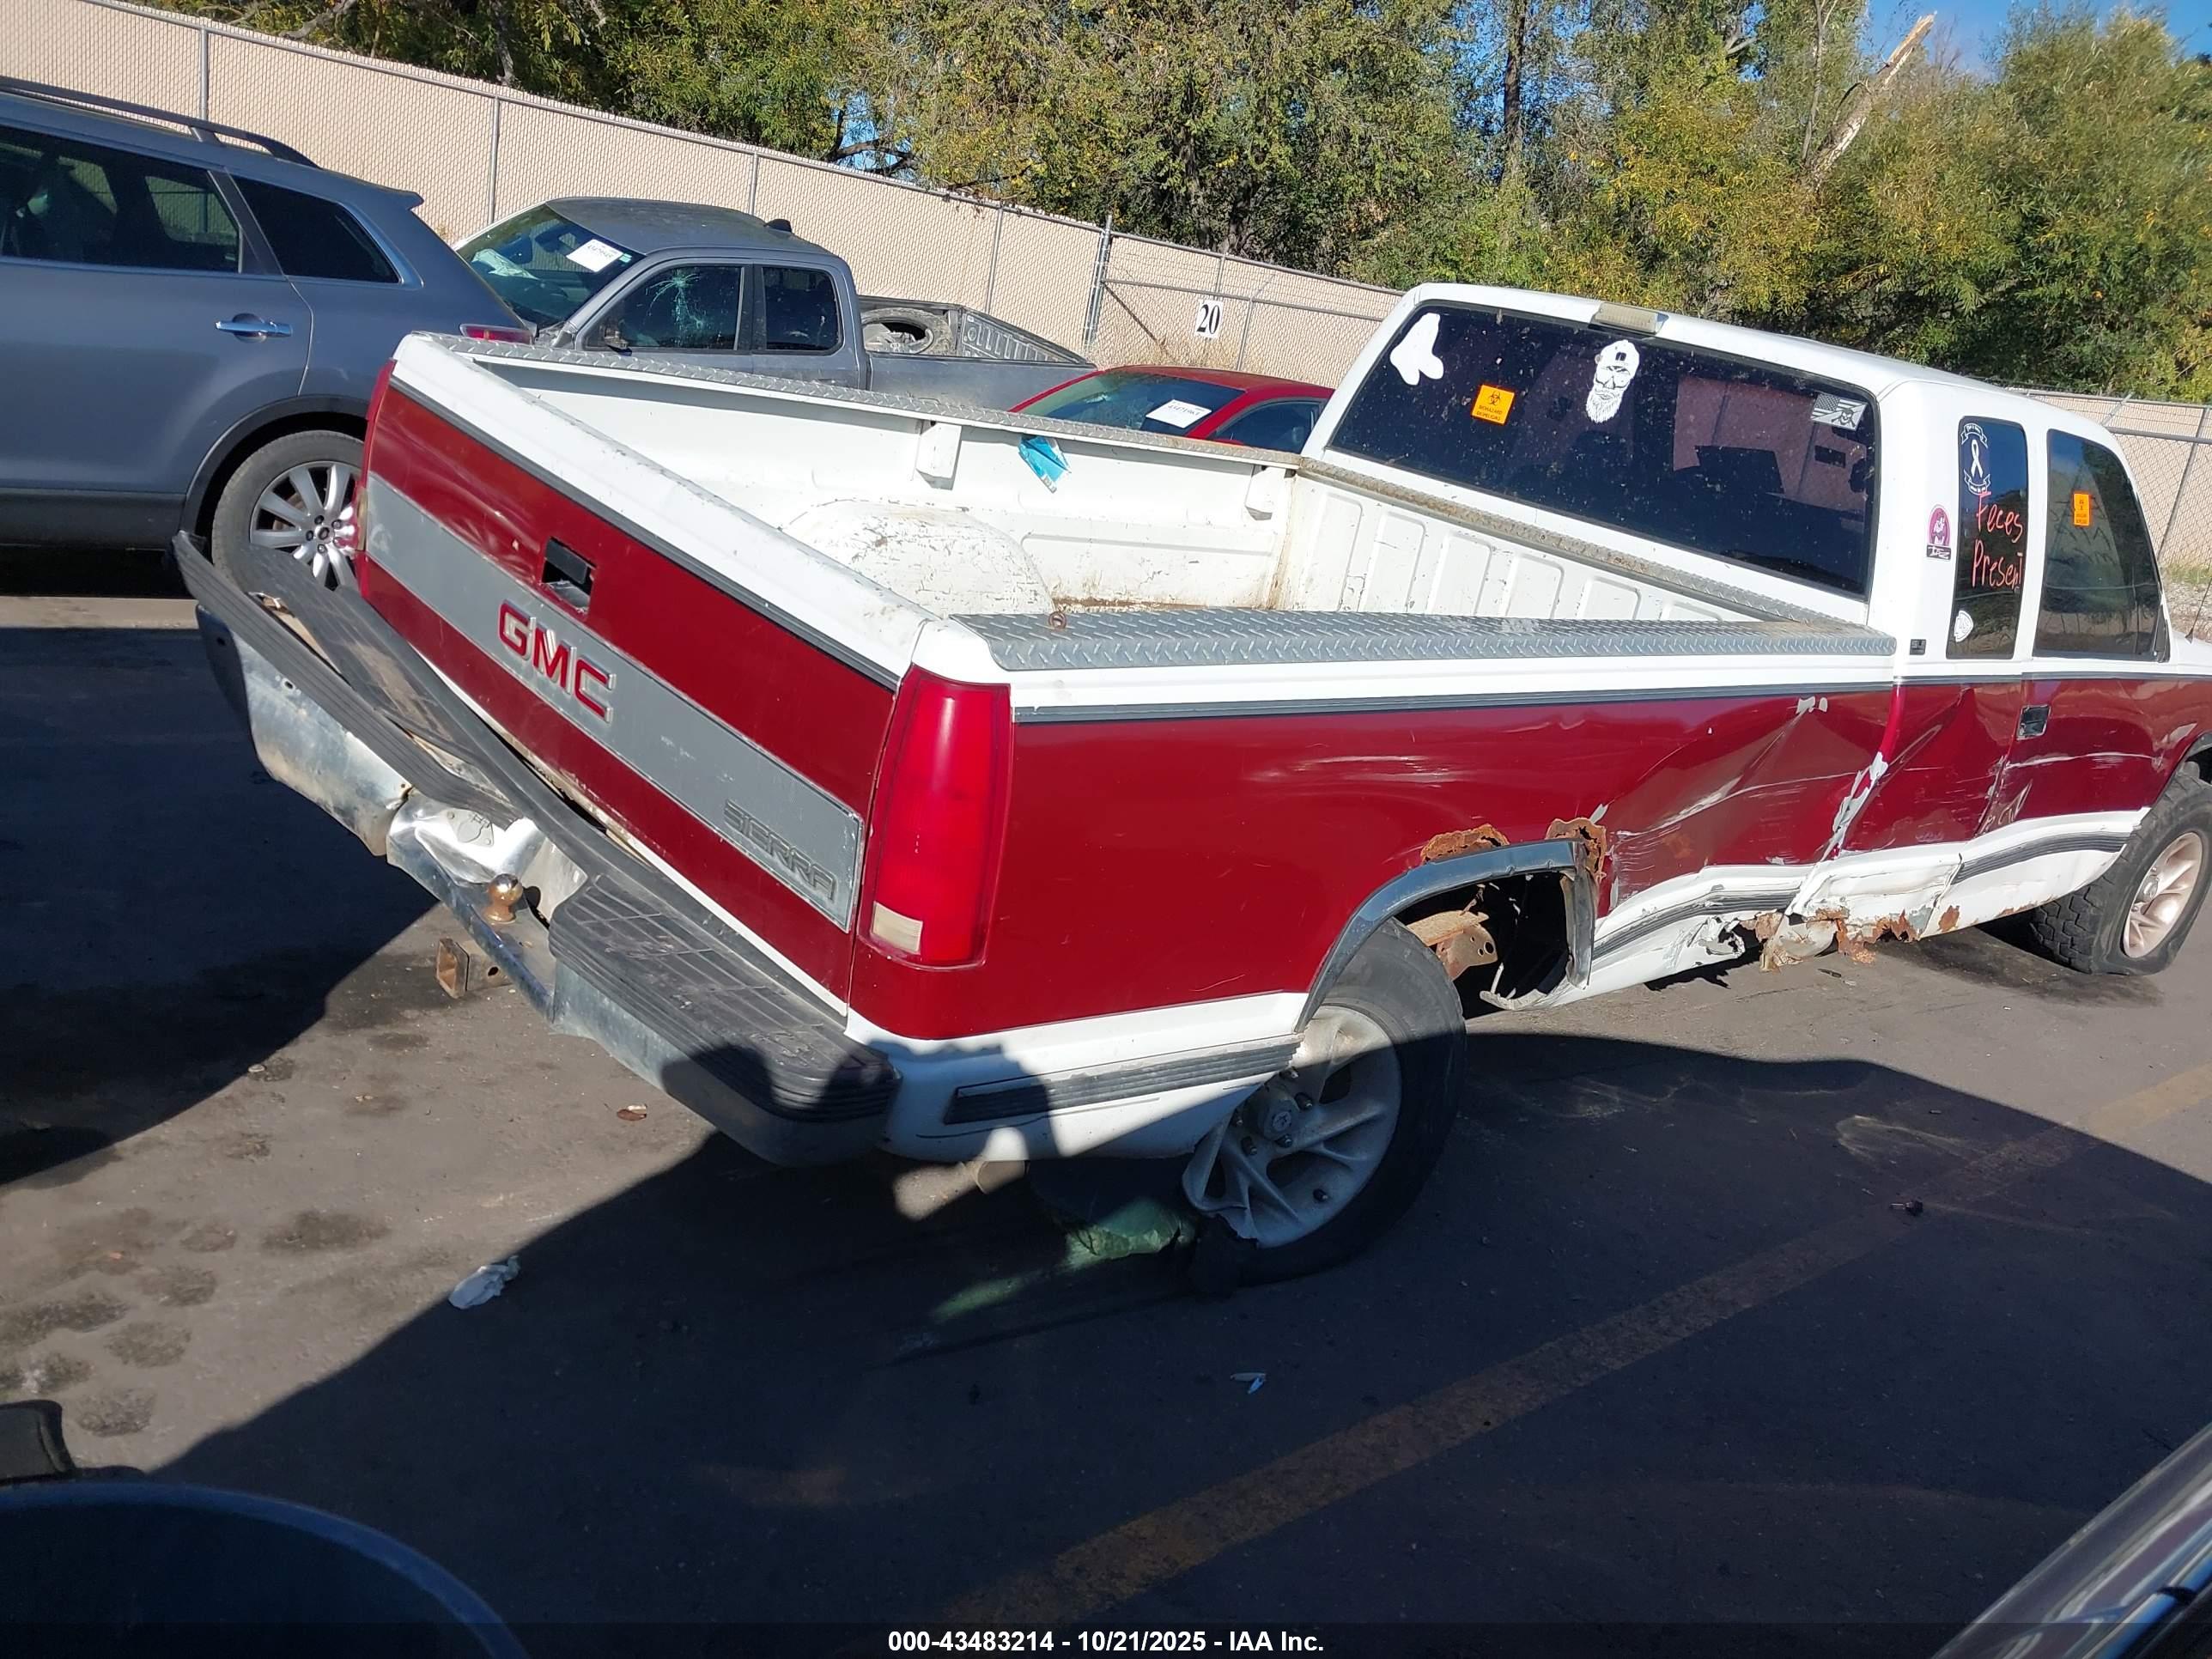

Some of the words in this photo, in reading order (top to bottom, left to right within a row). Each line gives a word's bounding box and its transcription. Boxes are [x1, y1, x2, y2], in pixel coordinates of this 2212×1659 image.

[1196, 304, 1220, 334] 20
[1976, 490, 2023, 543] Feces
[1972, 538, 2023, 590] Present
[498, 600, 616, 723] GMC
[724, 799, 838, 902] SIERRA
